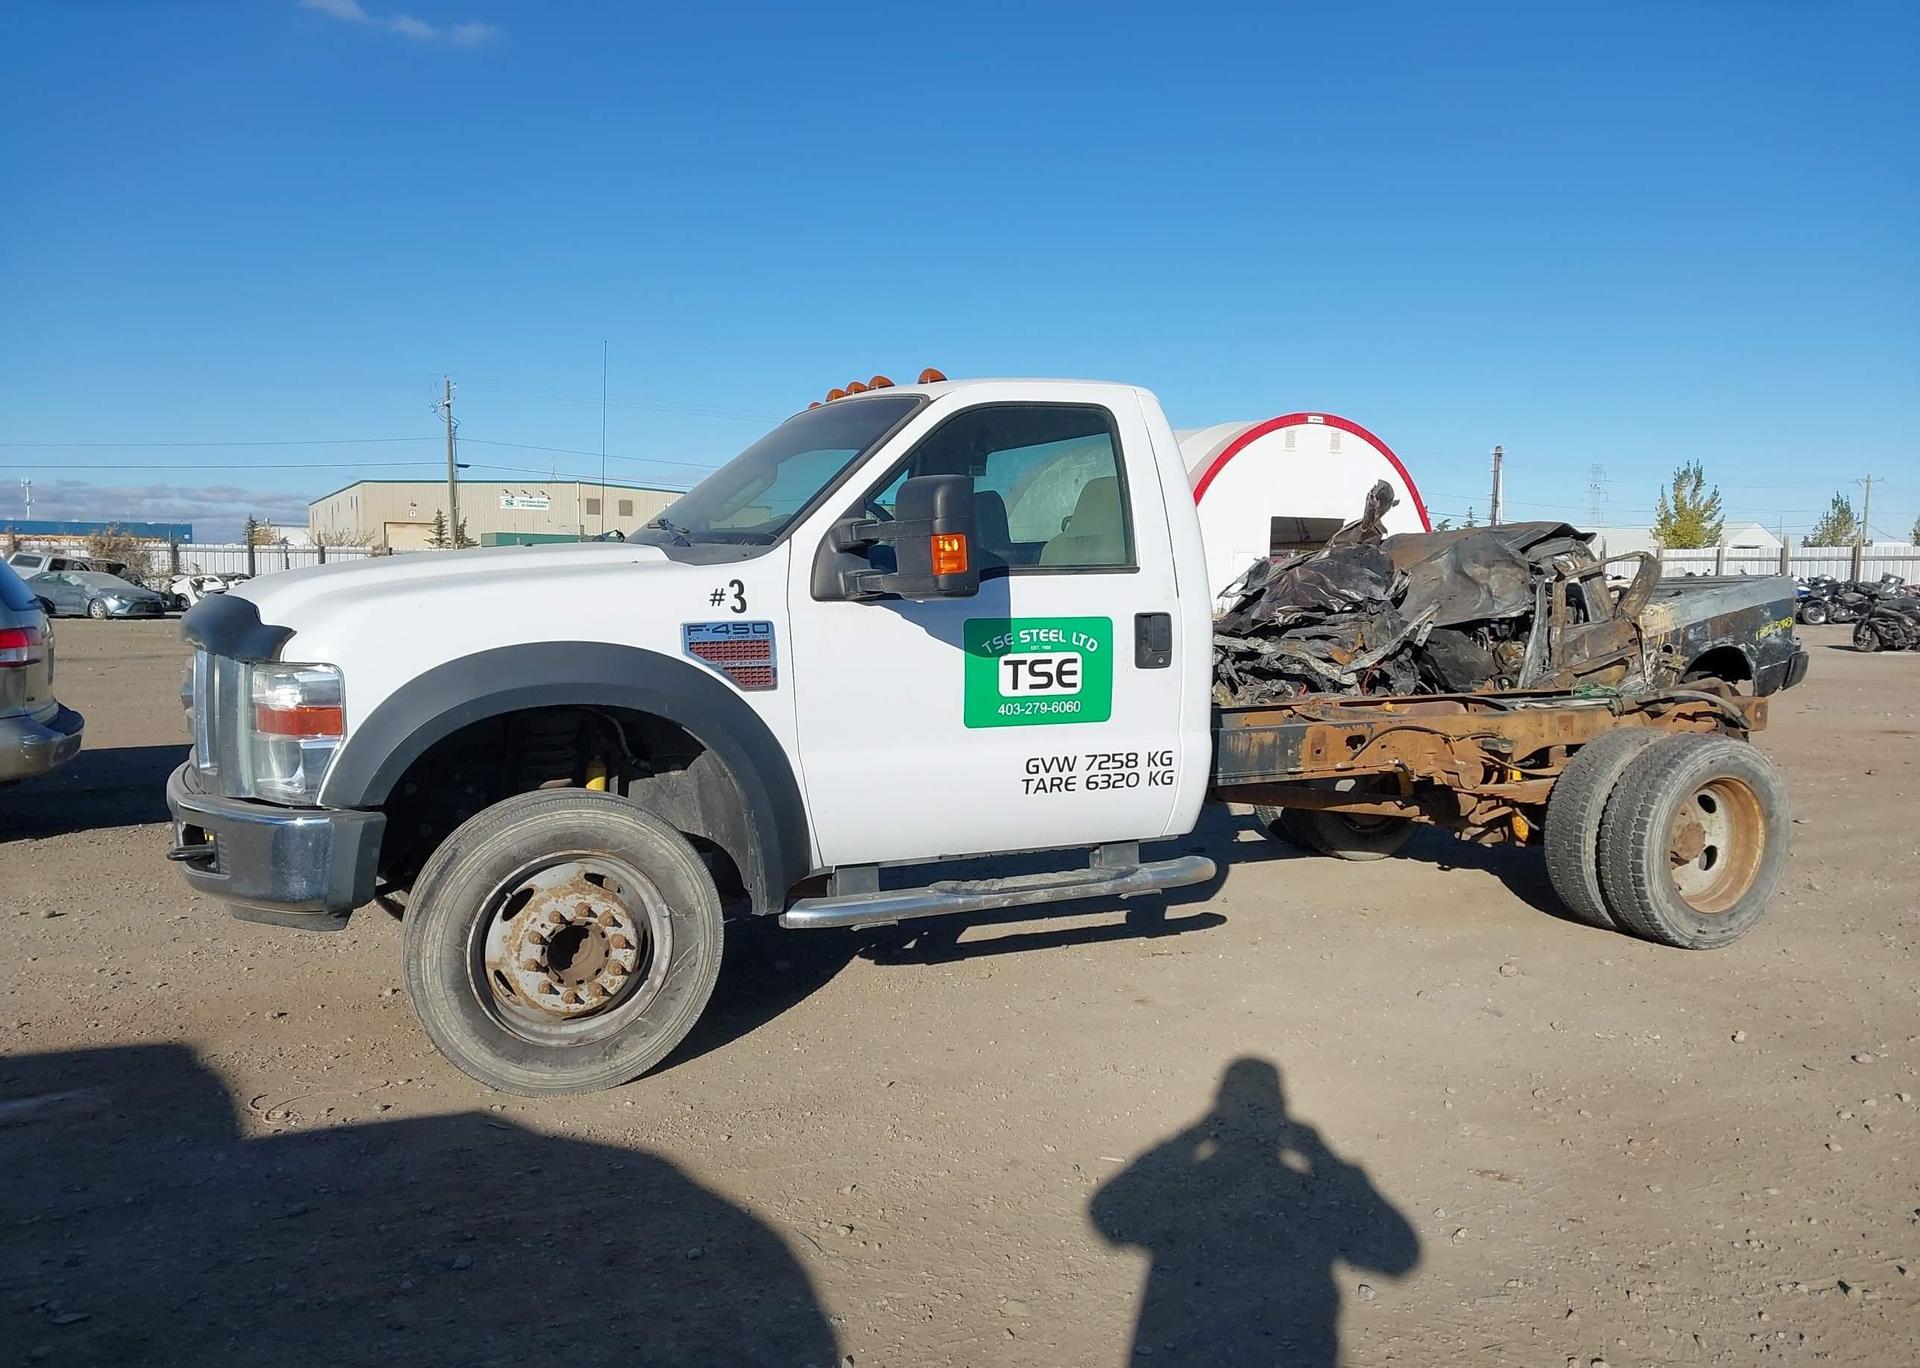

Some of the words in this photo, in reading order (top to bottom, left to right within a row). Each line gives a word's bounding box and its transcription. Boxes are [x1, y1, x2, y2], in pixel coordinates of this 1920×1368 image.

[709, 579, 747, 613] #3
[982, 632, 1015, 654] TSE
[1019, 629, 1067, 643] STEEL
[1072, 631, 1098, 652] LTD
[1003, 658, 1078, 690] TSE
[998, 701, 1081, 716] 403-279-6060
[1025, 755, 1077, 775] GVW
[1085, 752, 1139, 771] 7258
[1147, 750, 1173, 768] KG
[1021, 776, 1077, 795] TARE
[1085, 772, 1140, 790] 6320
[1148, 770, 1174, 787] KG
